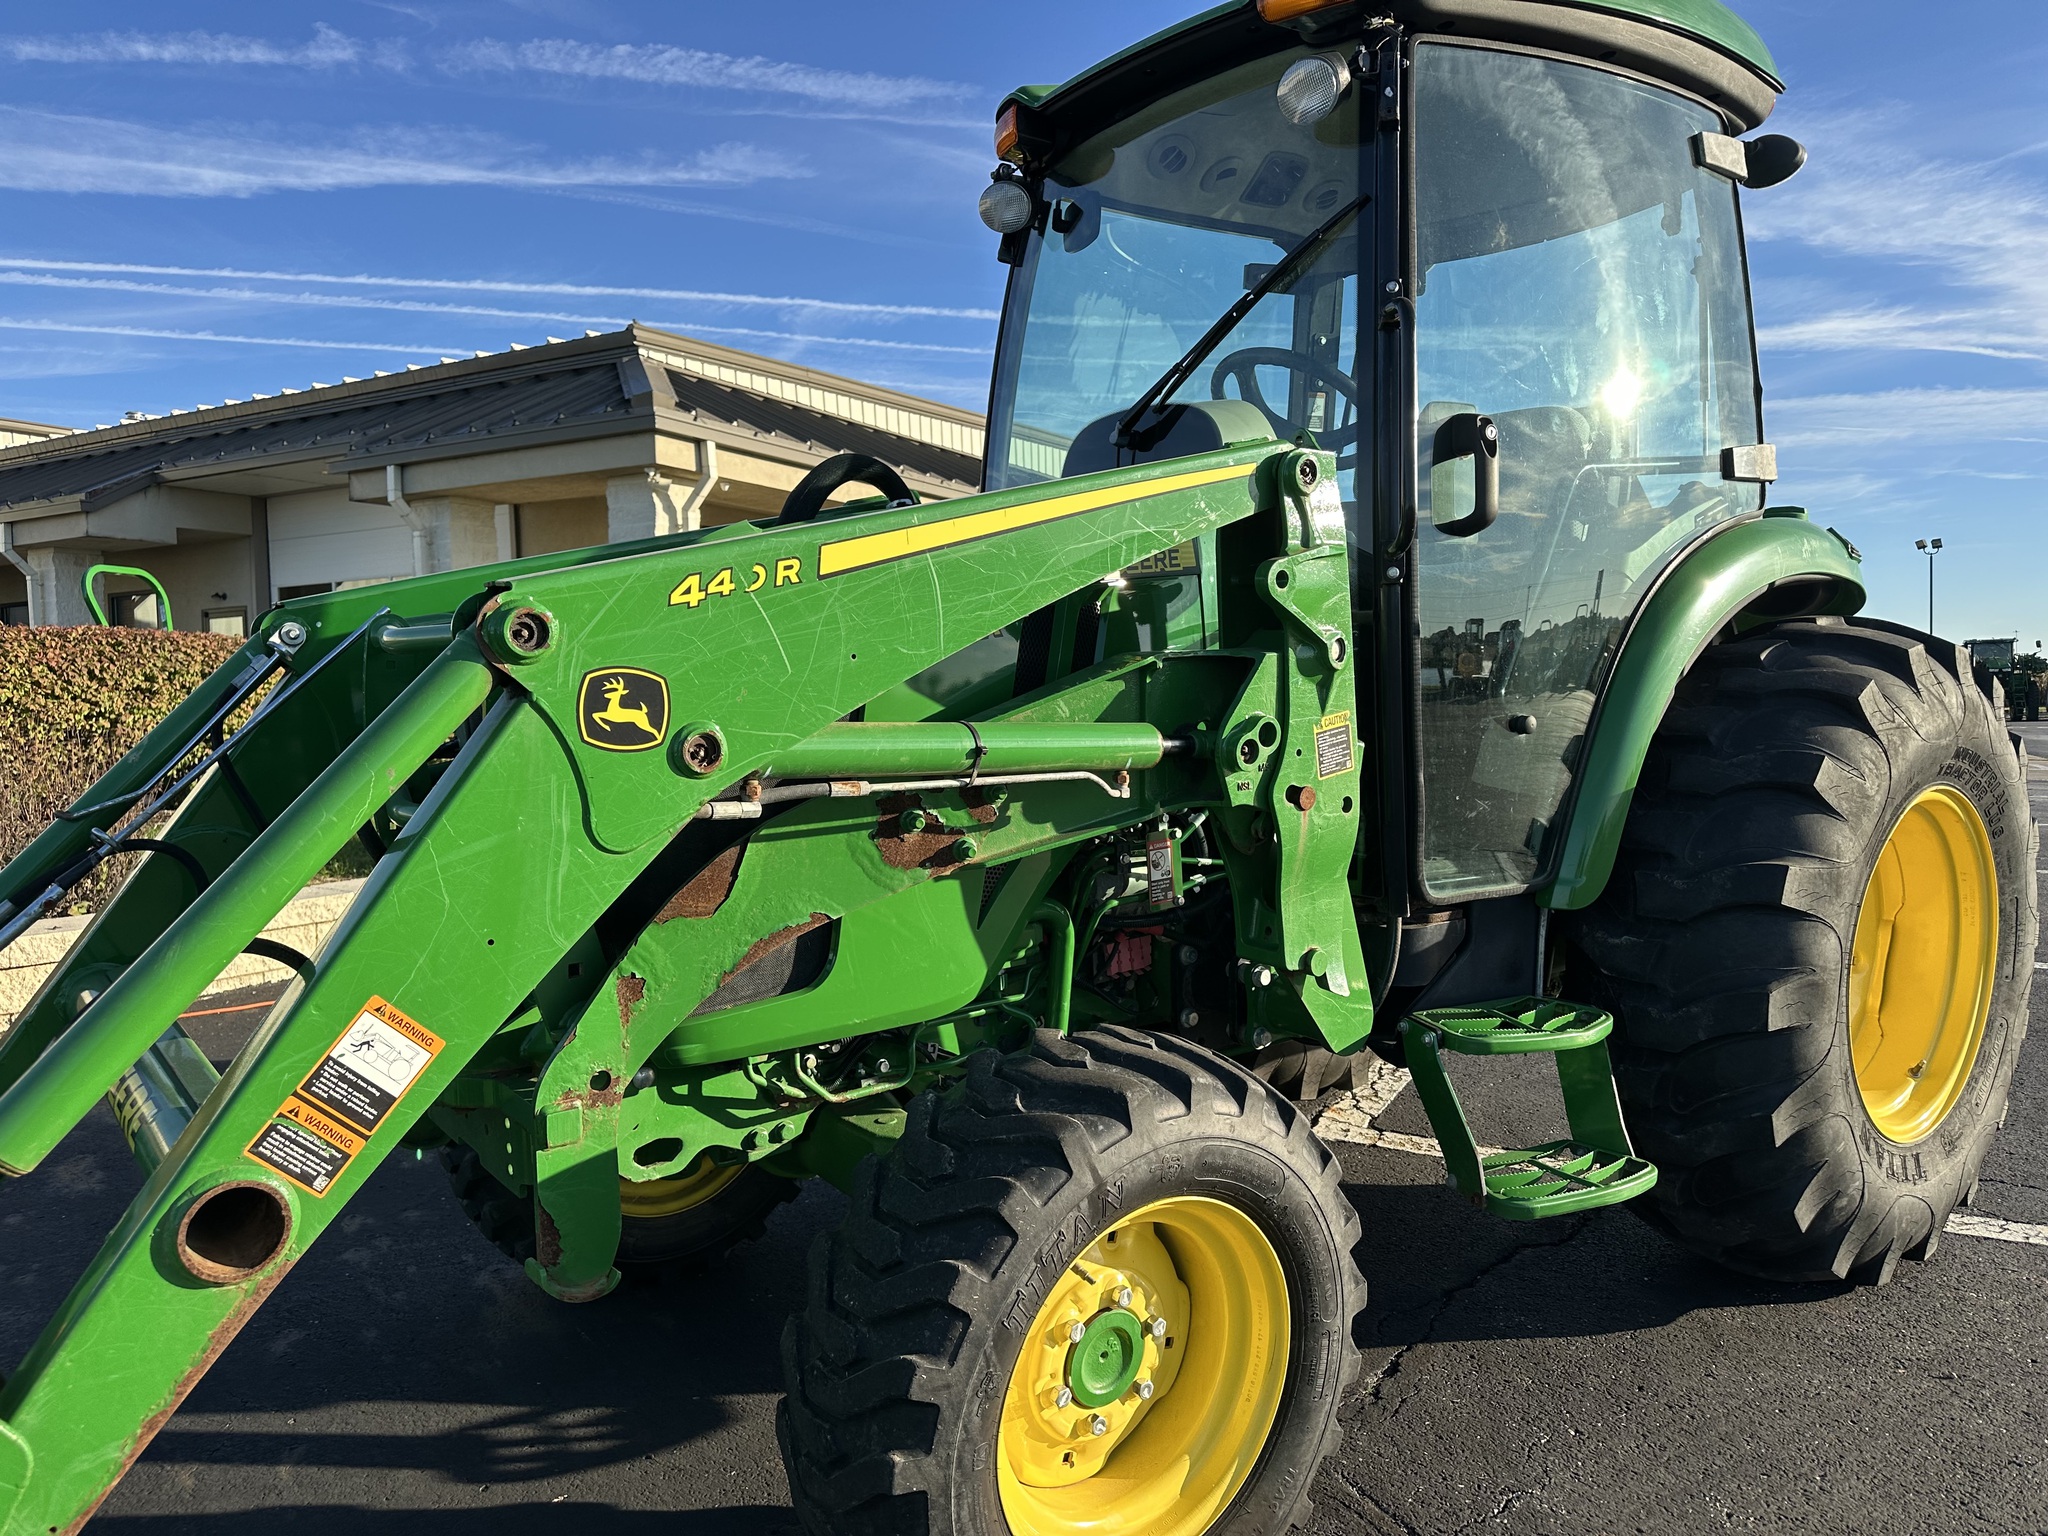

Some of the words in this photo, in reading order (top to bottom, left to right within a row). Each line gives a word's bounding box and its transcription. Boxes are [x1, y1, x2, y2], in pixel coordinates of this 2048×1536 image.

[1937, 762, 1988, 802] TRACTOR
[1984, 801, 2004, 839] LUG
[1951, 746, 2008, 815] INDUSTRIAL
[387, 1011, 435, 1048] WARNING
[304, 1113, 354, 1149] WARNING
[1859, 1119, 1928, 1186] TITAN
[1002, 1174, 1127, 1335] TITAN
